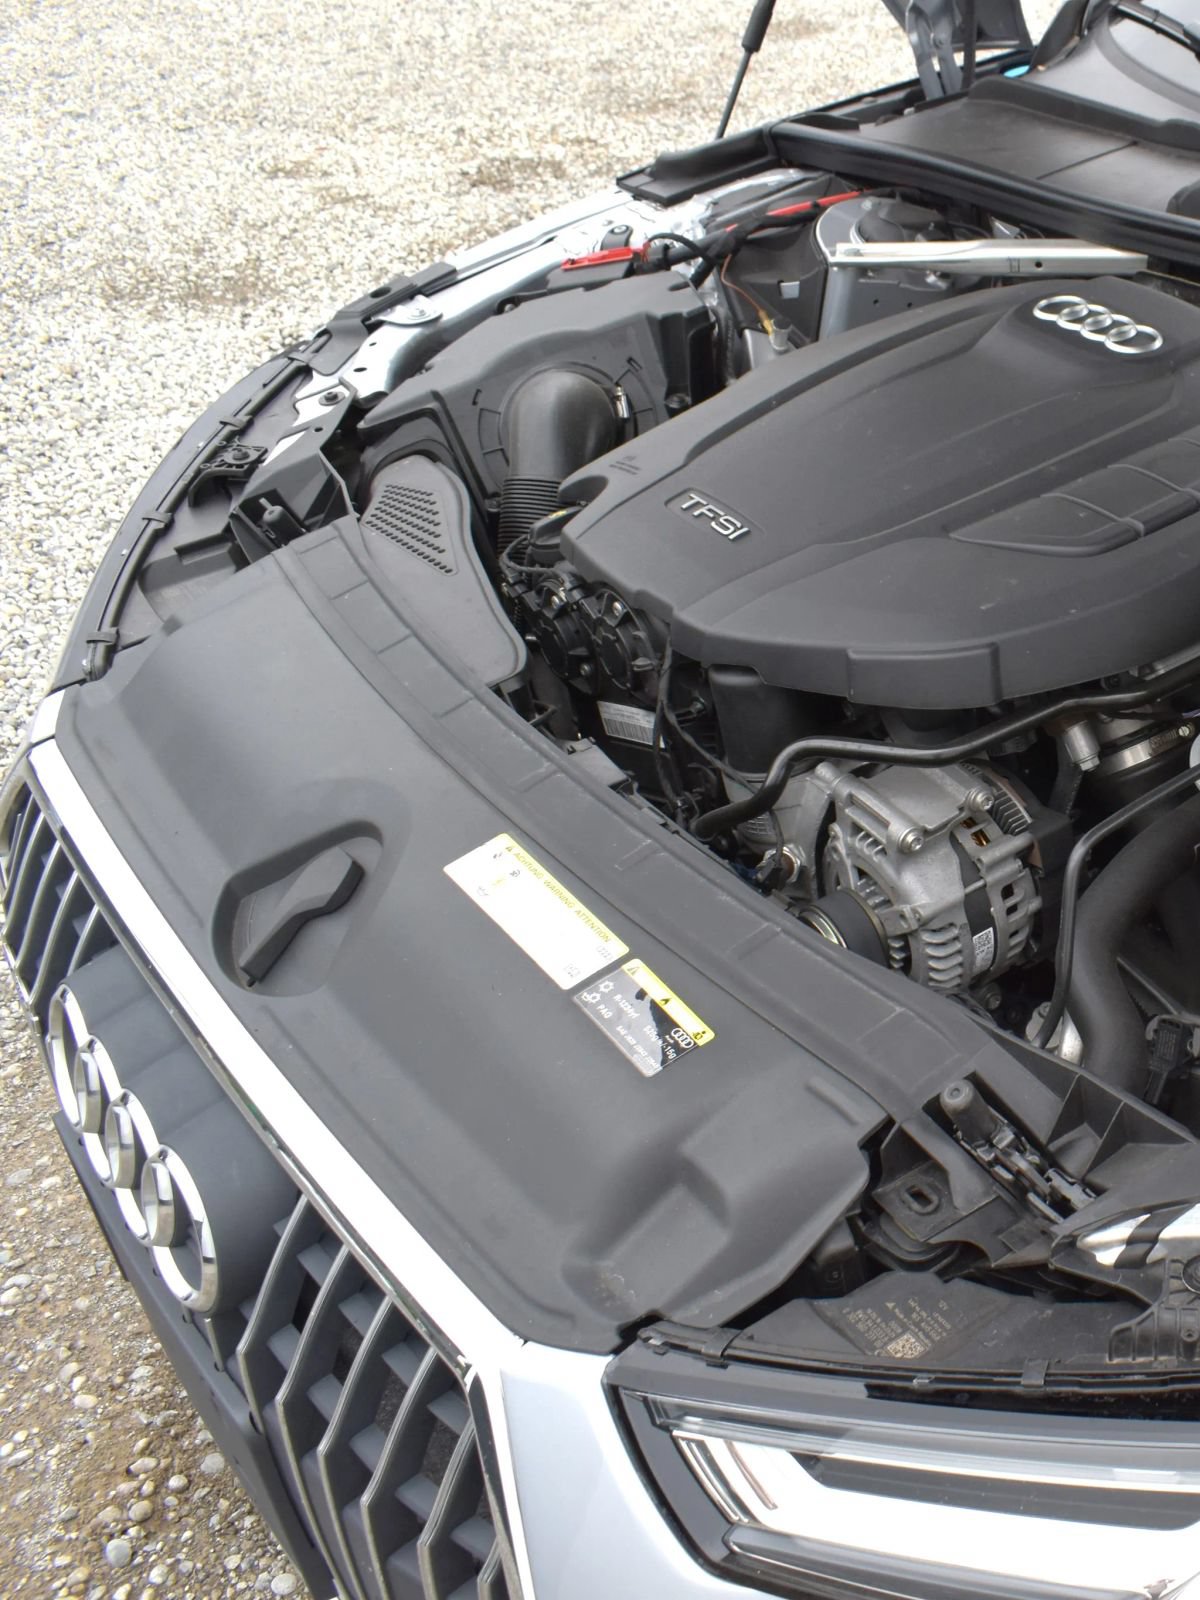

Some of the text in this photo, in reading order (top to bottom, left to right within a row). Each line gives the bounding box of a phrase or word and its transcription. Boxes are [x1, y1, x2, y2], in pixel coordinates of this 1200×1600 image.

[681, 493, 749, 541] TFSI
[513, 852, 611, 943] ACHTUNG WARNING ATTENTION
[596, 1004, 613, 1019] PAG
